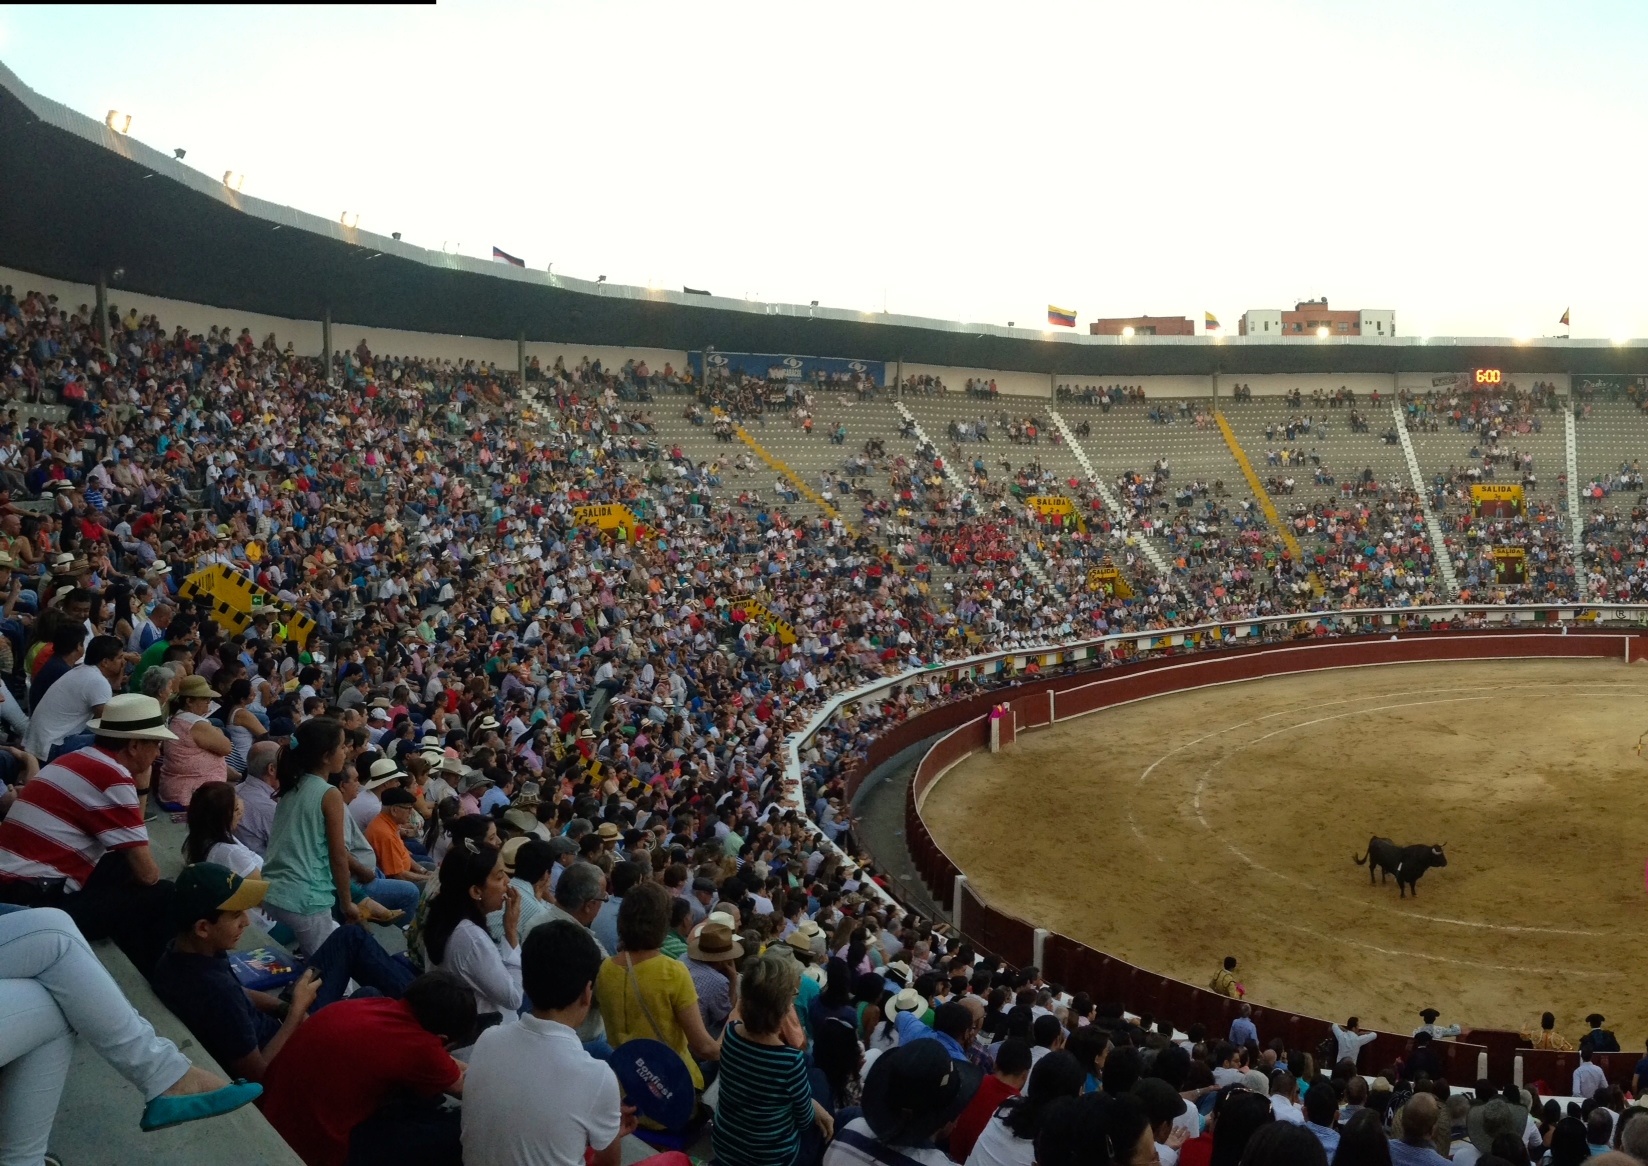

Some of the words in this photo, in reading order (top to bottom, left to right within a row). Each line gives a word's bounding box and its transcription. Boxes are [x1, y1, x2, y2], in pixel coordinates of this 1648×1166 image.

[1476, 370, 1500, 382] 6:00
[583, 507, 612, 517] SALIDA
[635, 1058, 673, 1099] Bonfiest
